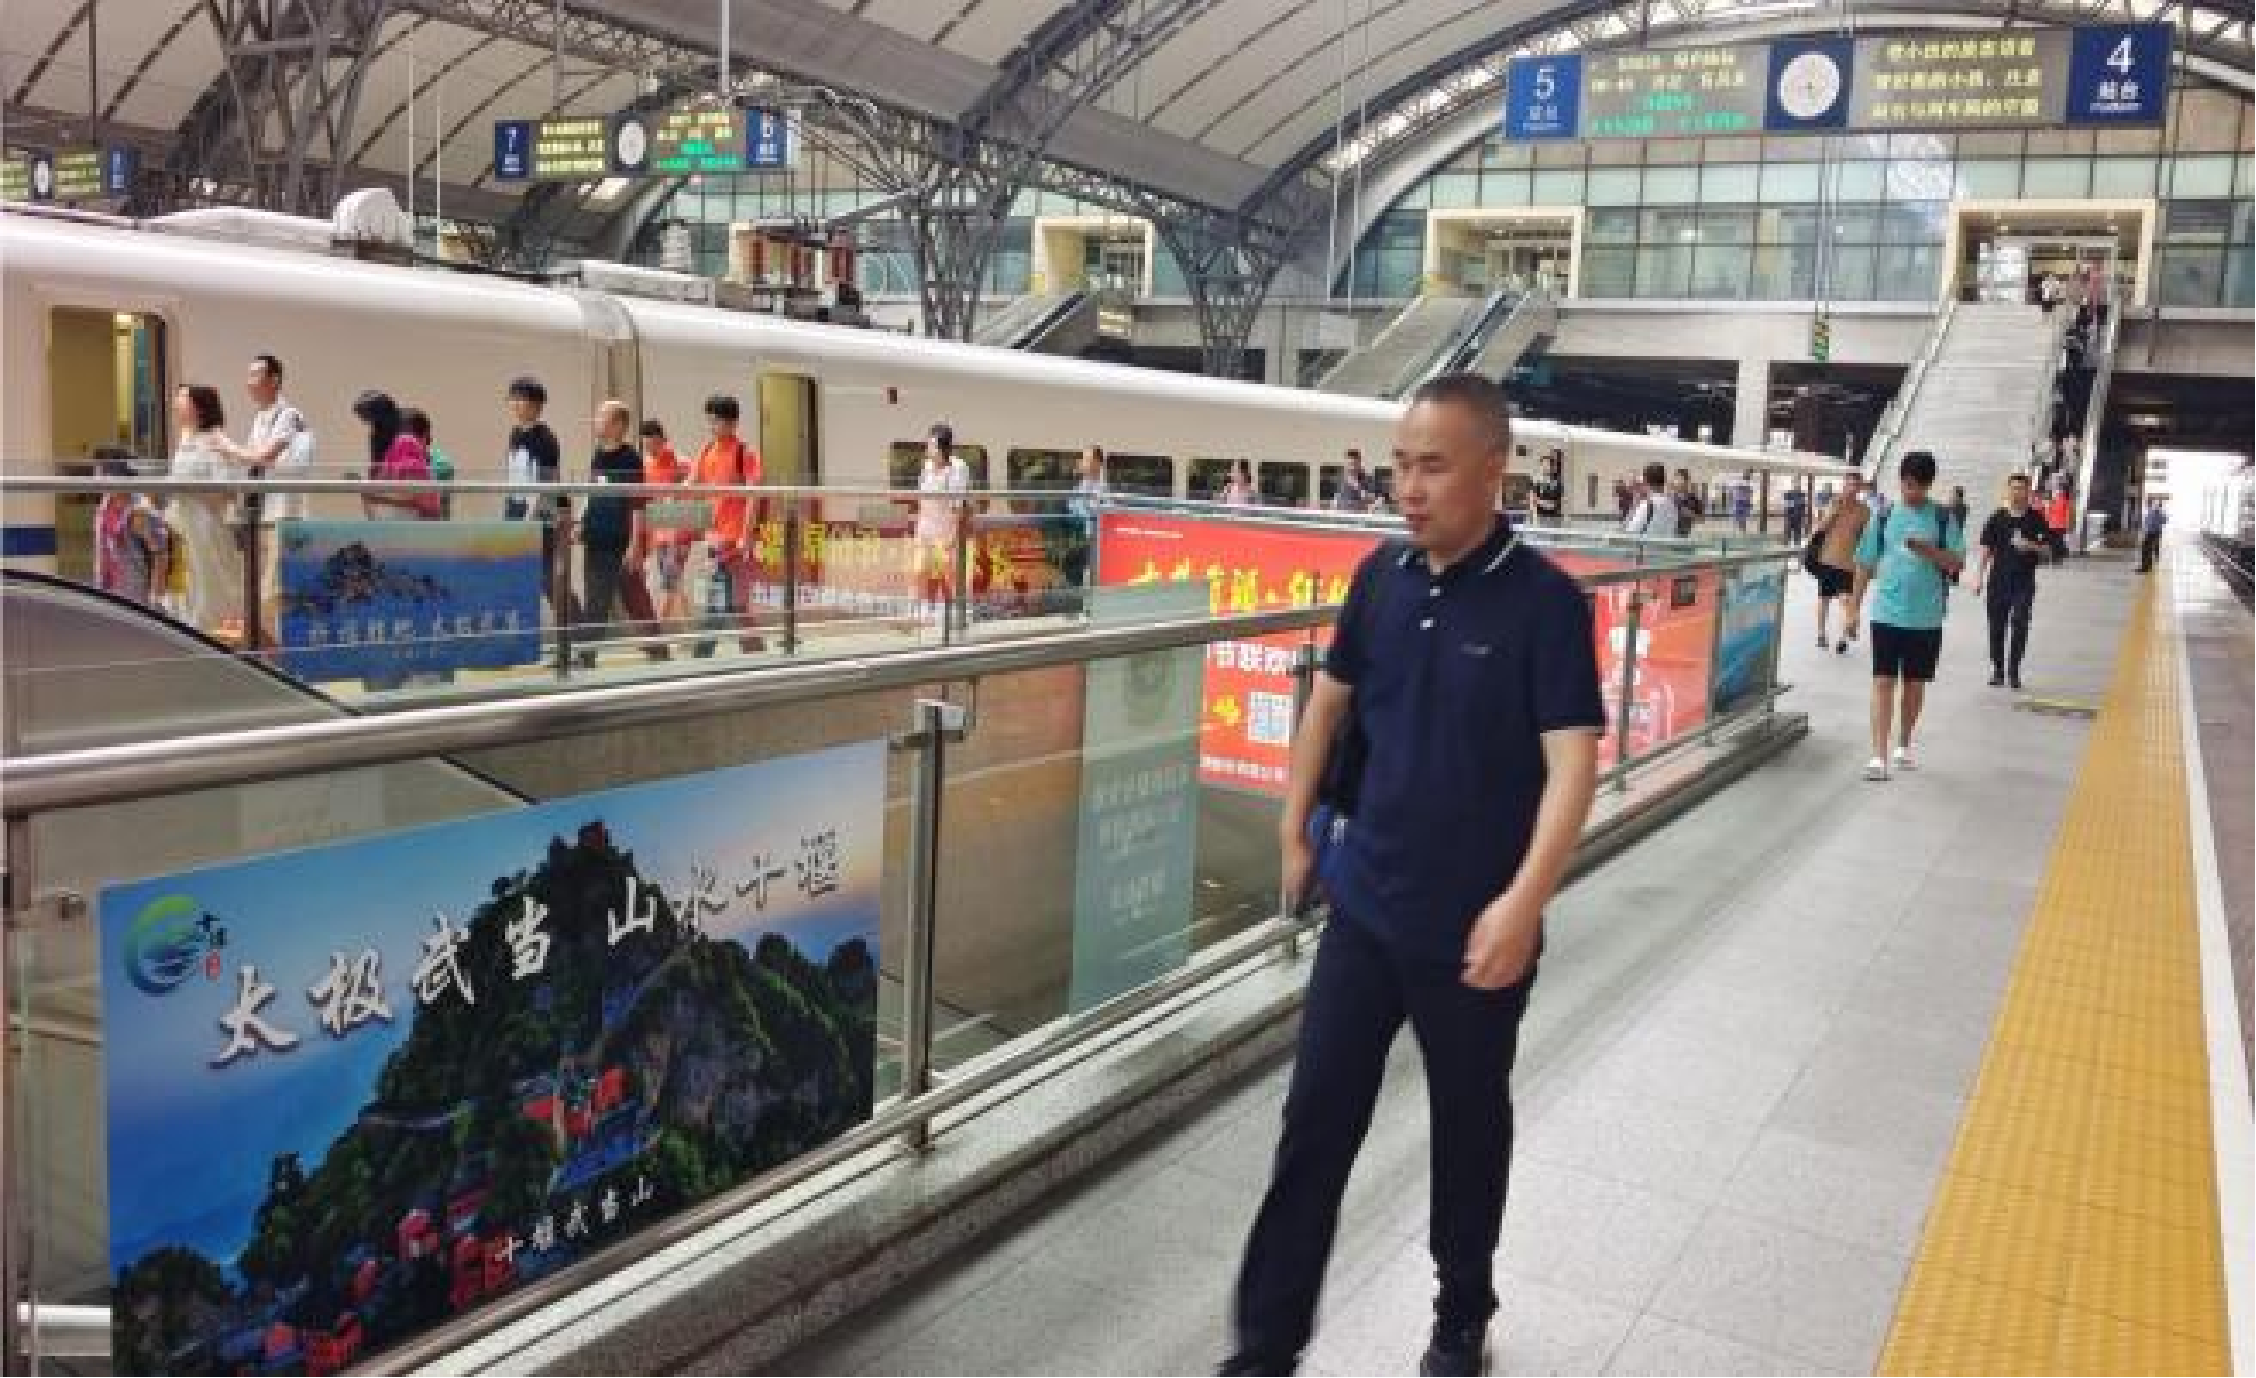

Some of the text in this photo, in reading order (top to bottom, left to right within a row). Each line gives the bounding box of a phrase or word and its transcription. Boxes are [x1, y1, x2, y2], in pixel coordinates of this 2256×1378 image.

[2106, 36, 2137, 74] 4
[1533, 65, 1556, 100] 5
[208, 895, 556, 1070] 太极武当
